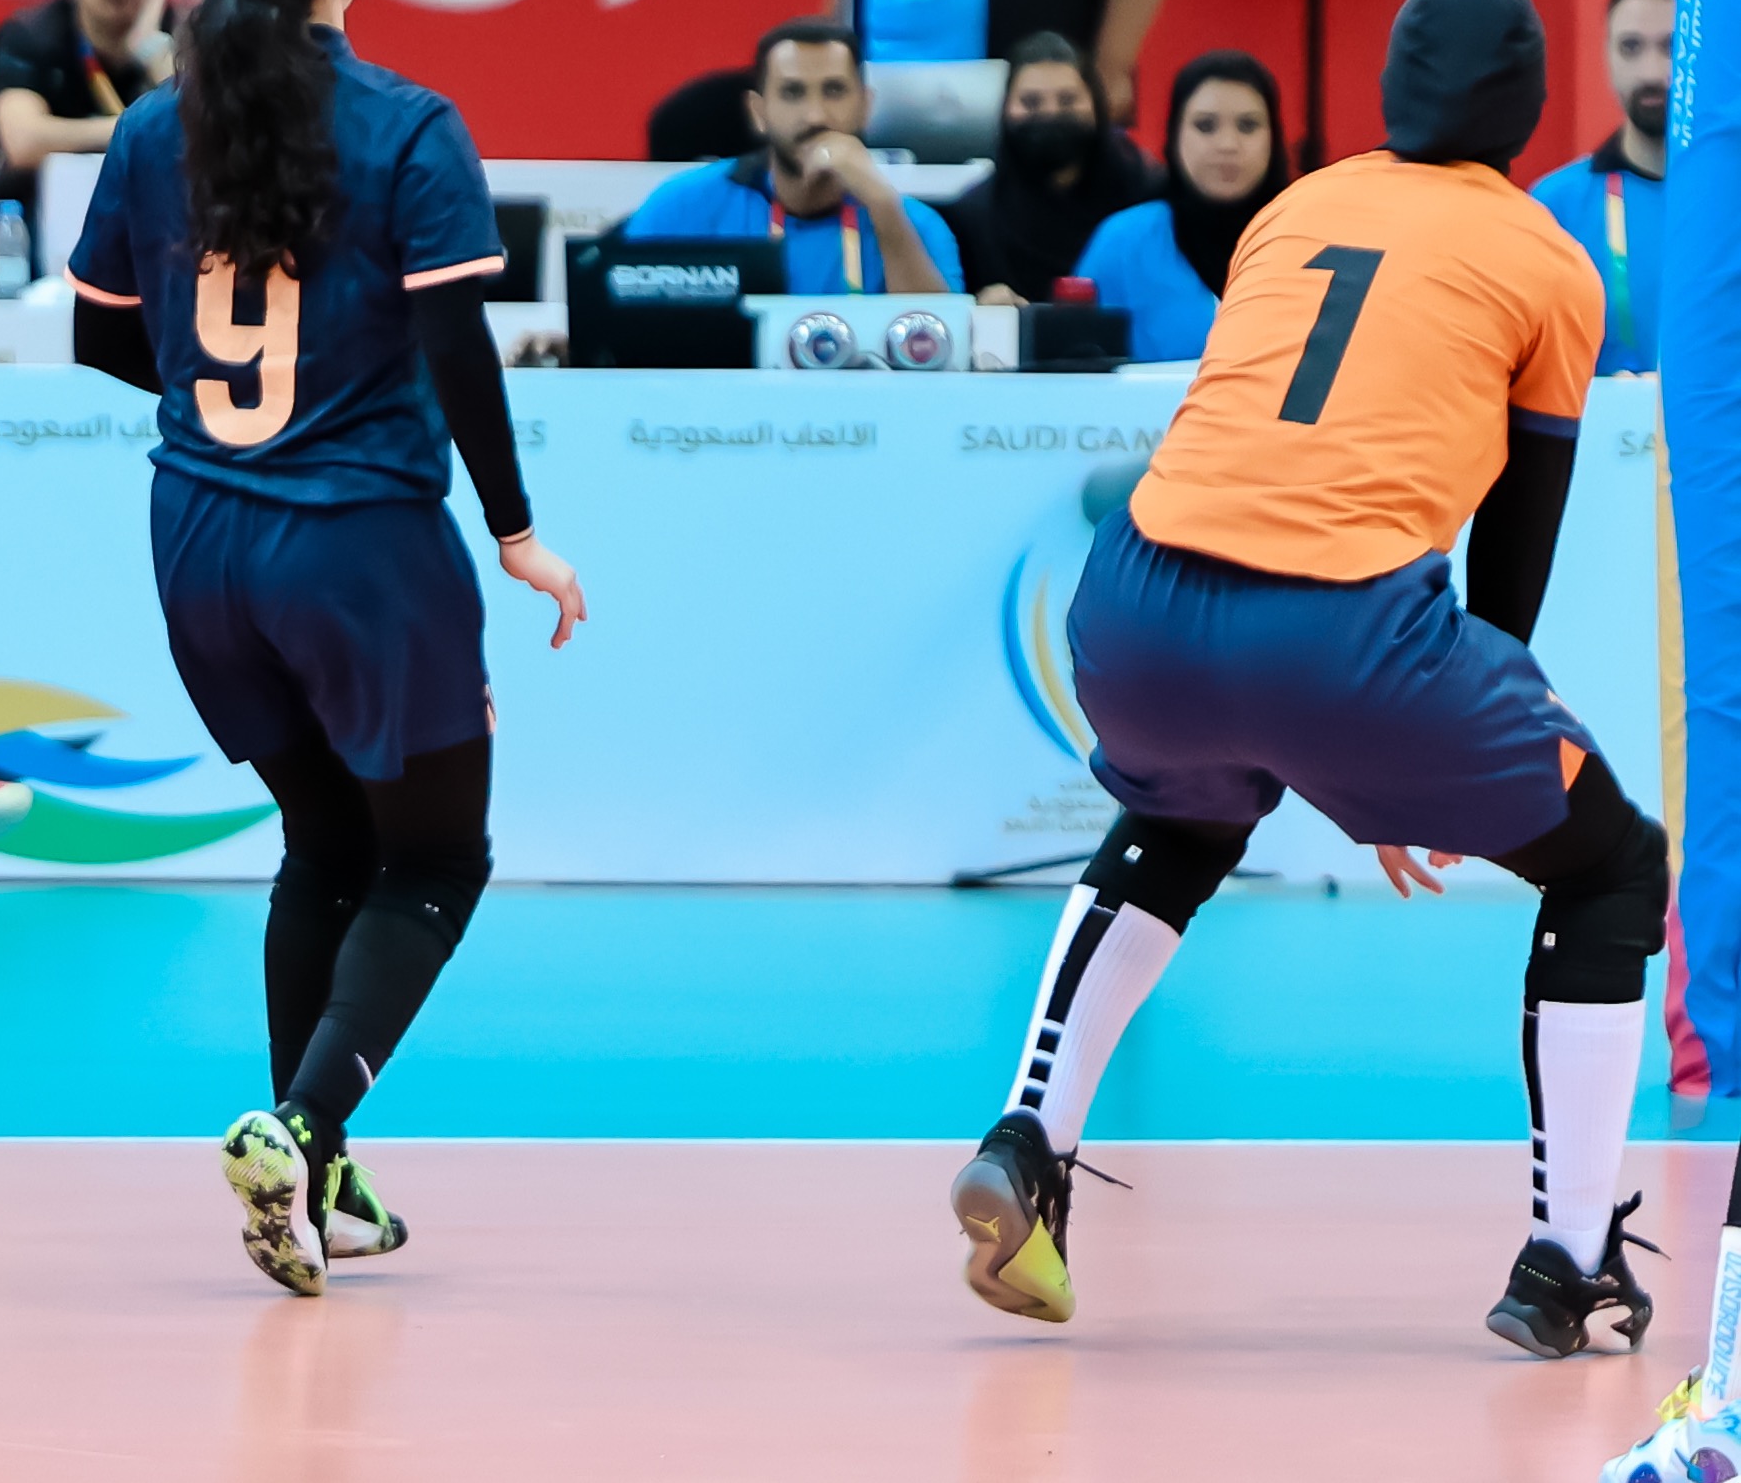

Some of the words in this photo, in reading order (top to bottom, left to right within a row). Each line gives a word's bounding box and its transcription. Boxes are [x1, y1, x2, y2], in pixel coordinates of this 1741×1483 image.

[195, 250, 300, 446] 9
[1277, 245, 1386, 426] 1
[961, 425, 1067, 451] SAUDI
[1076, 425, 1166, 452] GAM
